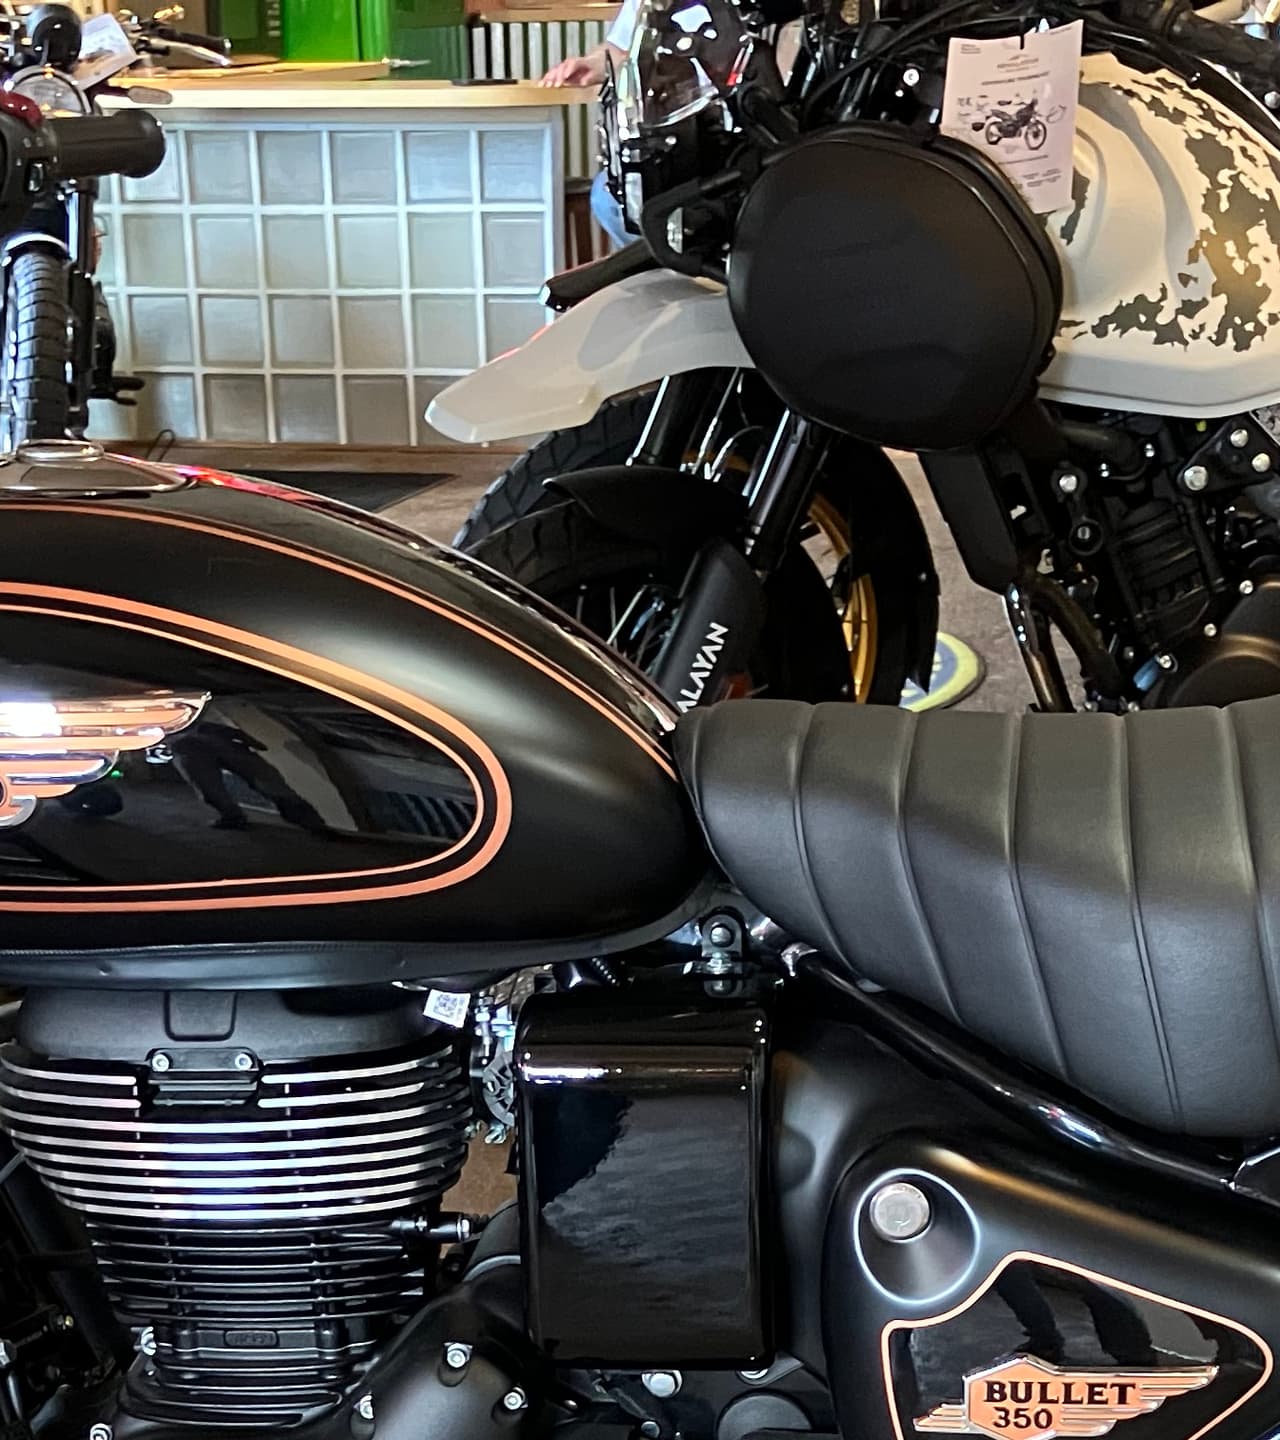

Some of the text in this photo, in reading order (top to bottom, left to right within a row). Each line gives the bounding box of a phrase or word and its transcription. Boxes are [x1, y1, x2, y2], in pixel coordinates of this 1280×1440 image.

[677, 622, 728, 713] ALAYAN
[984, 1380, 1137, 1406] BULLET
[993, 1407, 1053, 1430] 350
